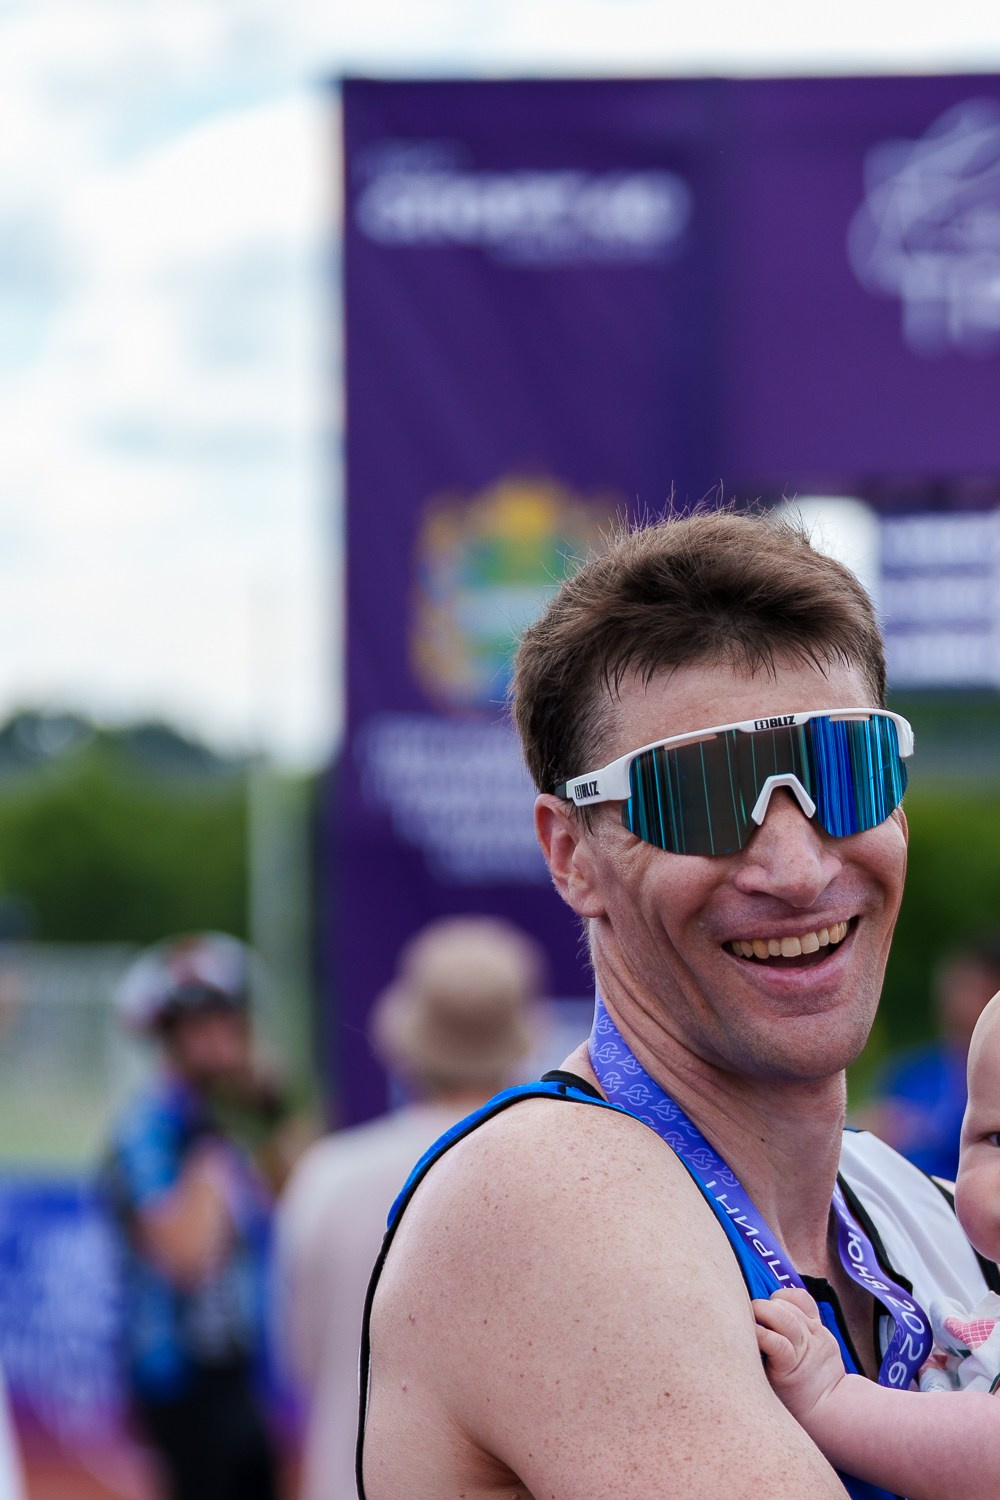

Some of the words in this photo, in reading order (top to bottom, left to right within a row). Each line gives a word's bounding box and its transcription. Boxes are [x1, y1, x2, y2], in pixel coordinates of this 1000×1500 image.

[769, 714, 796, 728] BLIZ
[581, 780, 600, 797] BLIZ
[883, 1294, 925, 1386] 2026
